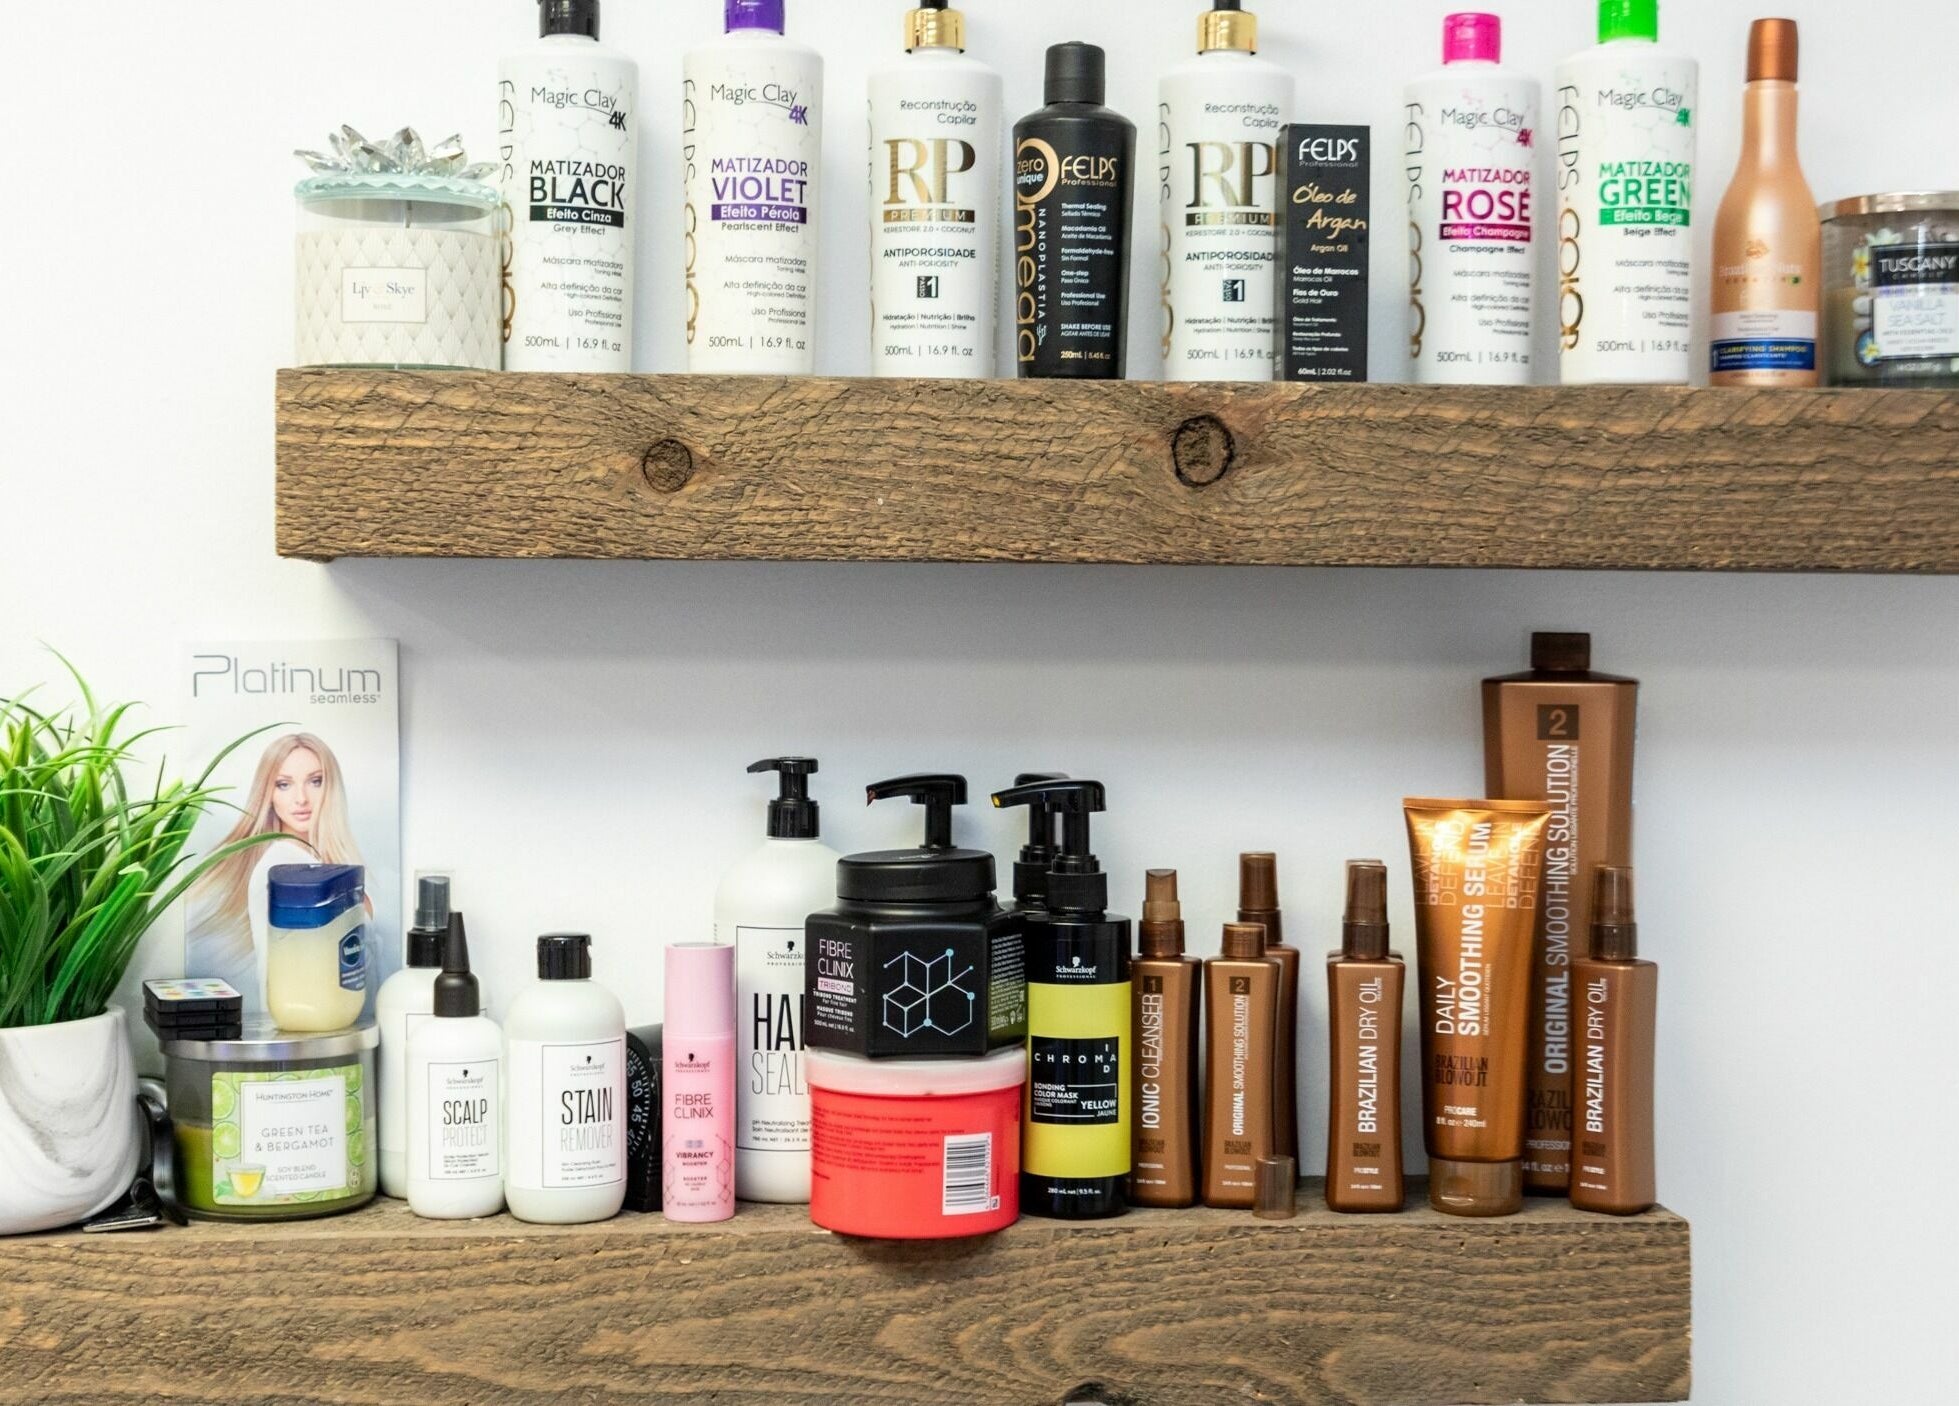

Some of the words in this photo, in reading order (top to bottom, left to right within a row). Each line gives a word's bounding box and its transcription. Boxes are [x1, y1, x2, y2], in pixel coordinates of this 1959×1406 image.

[531, 87, 578, 109] Magic
[584, 89, 617, 113] Clay
[711, 83, 757, 105] Magic
[763, 84, 797, 107] Clay
[1597, 88, 1646, 110] Magic
[1651, 87, 1682, 111] Clay
[788, 105, 808, 126] 4K
[900, 100, 977, 113] Reconstrução
[1204, 103, 1280, 115] Reconstrução
[608, 111, 627, 131] 4K
[937, 113, 977, 125] Capilar
[1242, 116, 1280, 128] Capilar
[1441, 107, 1488, 129] Magic
[1493, 107, 1524, 132] Clay
[1298, 138, 1360, 161] FELPS
[530, 160, 626, 182] MATIZADOR
[711, 158, 808, 178] MATIZADOR
[883, 138, 976, 204] RP
[1016, 158, 1045, 175] zero
[1061, 155, 1118, 180] FELPS
[1298, 160, 1359, 169] Professional
[1599, 161, 1690, 178] MATIZADOR
[1016, 172, 1044, 187] unique
[1061, 179, 1117, 188] Professional
[1185, 141, 1276, 208] RP
[1441, 168, 1530, 186] MATIZADOR
[530, 176, 625, 210] BLACK
[711, 176, 808, 204] VIOLET
[1292, 182, 1333, 204] Óleo
[1335, 188, 1358, 204] de
[1599, 178, 1690, 208] GREEN
[720, 206, 757, 218] Efeito
[761, 205, 800, 221] Pérola
[1442, 188, 1531, 222] ROSÉ
[547, 208, 579, 220] Efeito
[582, 209, 612, 223] Cinza
[890, 210, 966, 221] PREMIUM
[1305, 207, 1367, 239] Argan
[553, 224, 577, 235] Grey
[581, 225, 606, 236] Effect
[775, 223, 799, 233] Effect
[1442, 227, 1470, 237] Efeito
[1623, 227, 1651, 238] Beige
[1653, 228, 1676, 237] Effect
[883, 247, 976, 259] ANTIPOROSIDADE
[1310, 244, 1335, 254] Argan
[1449, 244, 1504, 255] Champagne
[1037, 208, 1047, 319] NANOPLASTIA
[1292, 265, 1312, 275] Óleo
[1312, 266, 1323, 275] de
[1878, 256, 1957, 273] TUSCANY
[386, 281, 416, 299] Skye
[1292, 288, 1307, 297] Fios
[1308, 288, 1319, 296] de
[1319, 289, 1338, 297] Ouro
[525, 336, 560, 348] 500mL
[577, 336, 599, 350] 16.9
[709, 336, 744, 348] 500mL
[761, 336, 782, 348] 16.9
[884, 346, 913, 357] 500mL
[928, 345, 948, 357] 16.9
[1596, 340, 1635, 352] 500mL
[1186, 348, 1219, 360] 500mL
[1235, 348, 1254, 360] 16.9
[193, 654, 381, 698] Platinum
[1549, 708, 1568, 736] 2
[1545, 743, 1570, 842] SOLUTION
[1463, 822, 1492, 897] SERUM
[1545, 847, 1570, 967] SMOOTHING
[819, 938, 852, 960] FIBRE
[817, 957, 854, 979] CLINIX
[1055, 965, 1097, 976] Schwarzkopf
[1457, 904, 1486, 1037] SMOOTHING
[818, 980, 852, 994] TRIBOND
[1235, 978, 1245, 992] 2
[1358, 977, 1378, 1004] OIL
[1586, 977, 1605, 1004] OIL
[1435, 976, 1456, 1036] DAILY
[753, 992, 805, 1051] HAI
[1233, 994, 1245, 1038] SOLUTION
[1358, 1007, 1378, 1040] DRY
[1544, 971, 1569, 1074] ORIGINAL
[1586, 1006, 1605, 1040] DRY
[1141, 993, 1160, 1079] CLEANSER
[1034, 1052, 1117, 1064] CHROMA
[1233, 1038, 1245, 1090] SMOOTHING
[631, 1079, 643, 1098] 50
[1034, 1081, 1066, 1092] BONDING
[1034, 1090, 1056, 1098] COLOR
[1057, 1092, 1079, 1100] MASK
[1357, 1045, 1378, 1133] BRAZILIAN
[1586, 1045, 1605, 1134] BRAZILIAN
[256, 1092, 308, 1102] HUNTINGTON
[561, 1086, 612, 1125] STAIN
[675, 1093, 713, 1106] FIBRE
[1080, 1099, 1117, 1110] YELLOW
[1141, 1083, 1160, 1129] IONIC
[443, 1098, 488, 1125] SCALP
[631, 1104, 643, 1123] 45
[674, 1106, 714, 1120] CLINIX
[1096, 1109, 1117, 1117] JAUNE
[1232, 1090, 1245, 1137] ORIGINAL
[261, 1127, 304, 1139] GREEN
[309, 1124, 329, 1136] TEA
[442, 1125, 489, 1148] PROTECT
[560, 1123, 613, 1152] REMOVER
[254, 1143, 262, 1153] &
[267, 1137, 334, 1153] BERGAMOT
[676, 1151, 714, 1159] VIBRANCY
[266, 1174, 299, 1183] SCENTED
